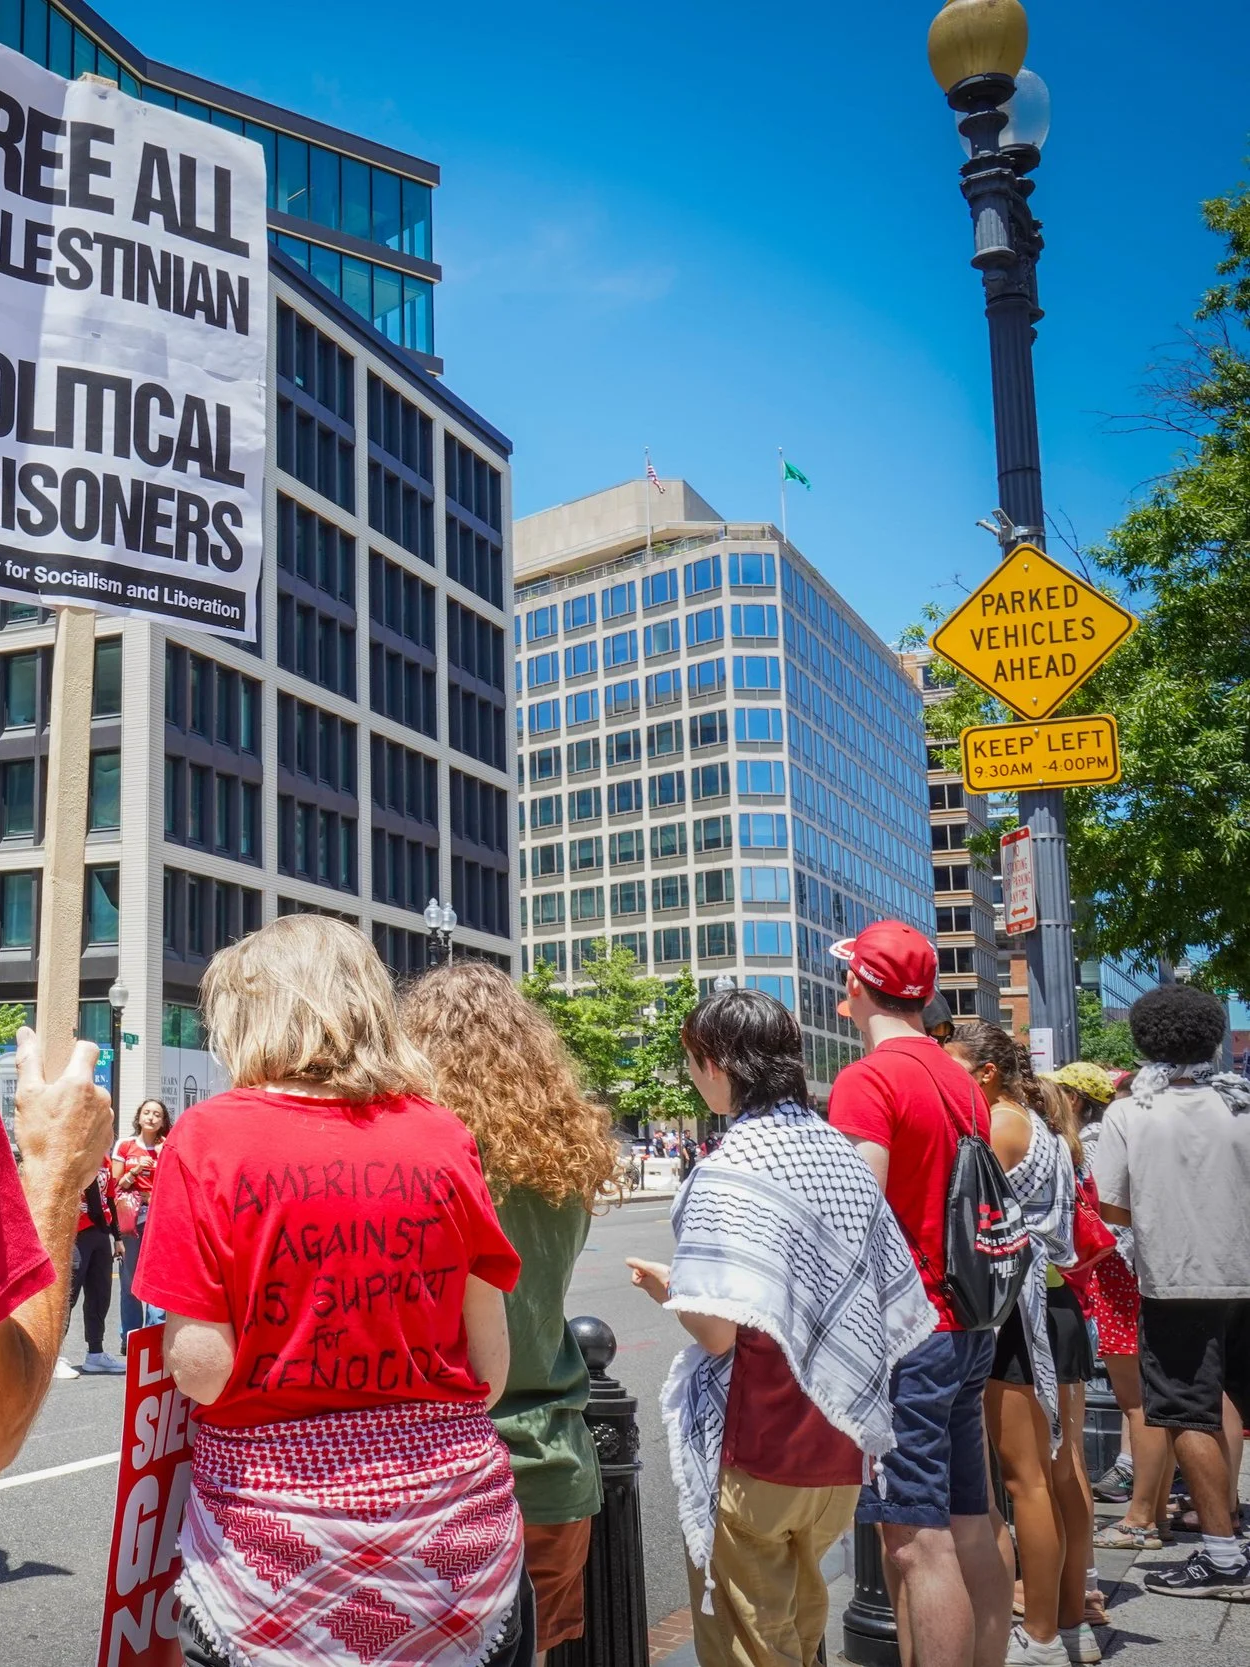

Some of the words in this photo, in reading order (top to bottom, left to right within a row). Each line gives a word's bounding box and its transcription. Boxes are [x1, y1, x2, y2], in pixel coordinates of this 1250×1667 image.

[132, 142, 250, 259] ALL
[5, 560, 30, 579] for
[34, 566, 122, 595] Socialism
[126, 584, 159, 602] and
[163, 587, 240, 620] Liberation
[981, 585, 1078, 616] PARKED
[970, 616, 1096, 651] VEHICLES
[993, 653, 1076, 683] AHEAD
[973, 736, 1033, 758] KEEP
[1047, 730, 1104, 752] LEFT
[974, 762, 1033, 778] 9:30AM
[234, 1160, 456, 1223] AMERICANS
[269, 1216, 444, 1269] AGAINST
[311, 1265, 458, 1319] SUPPORT
[308, 1324, 349, 1363] for
[131, 1388, 197, 1470] SIE
